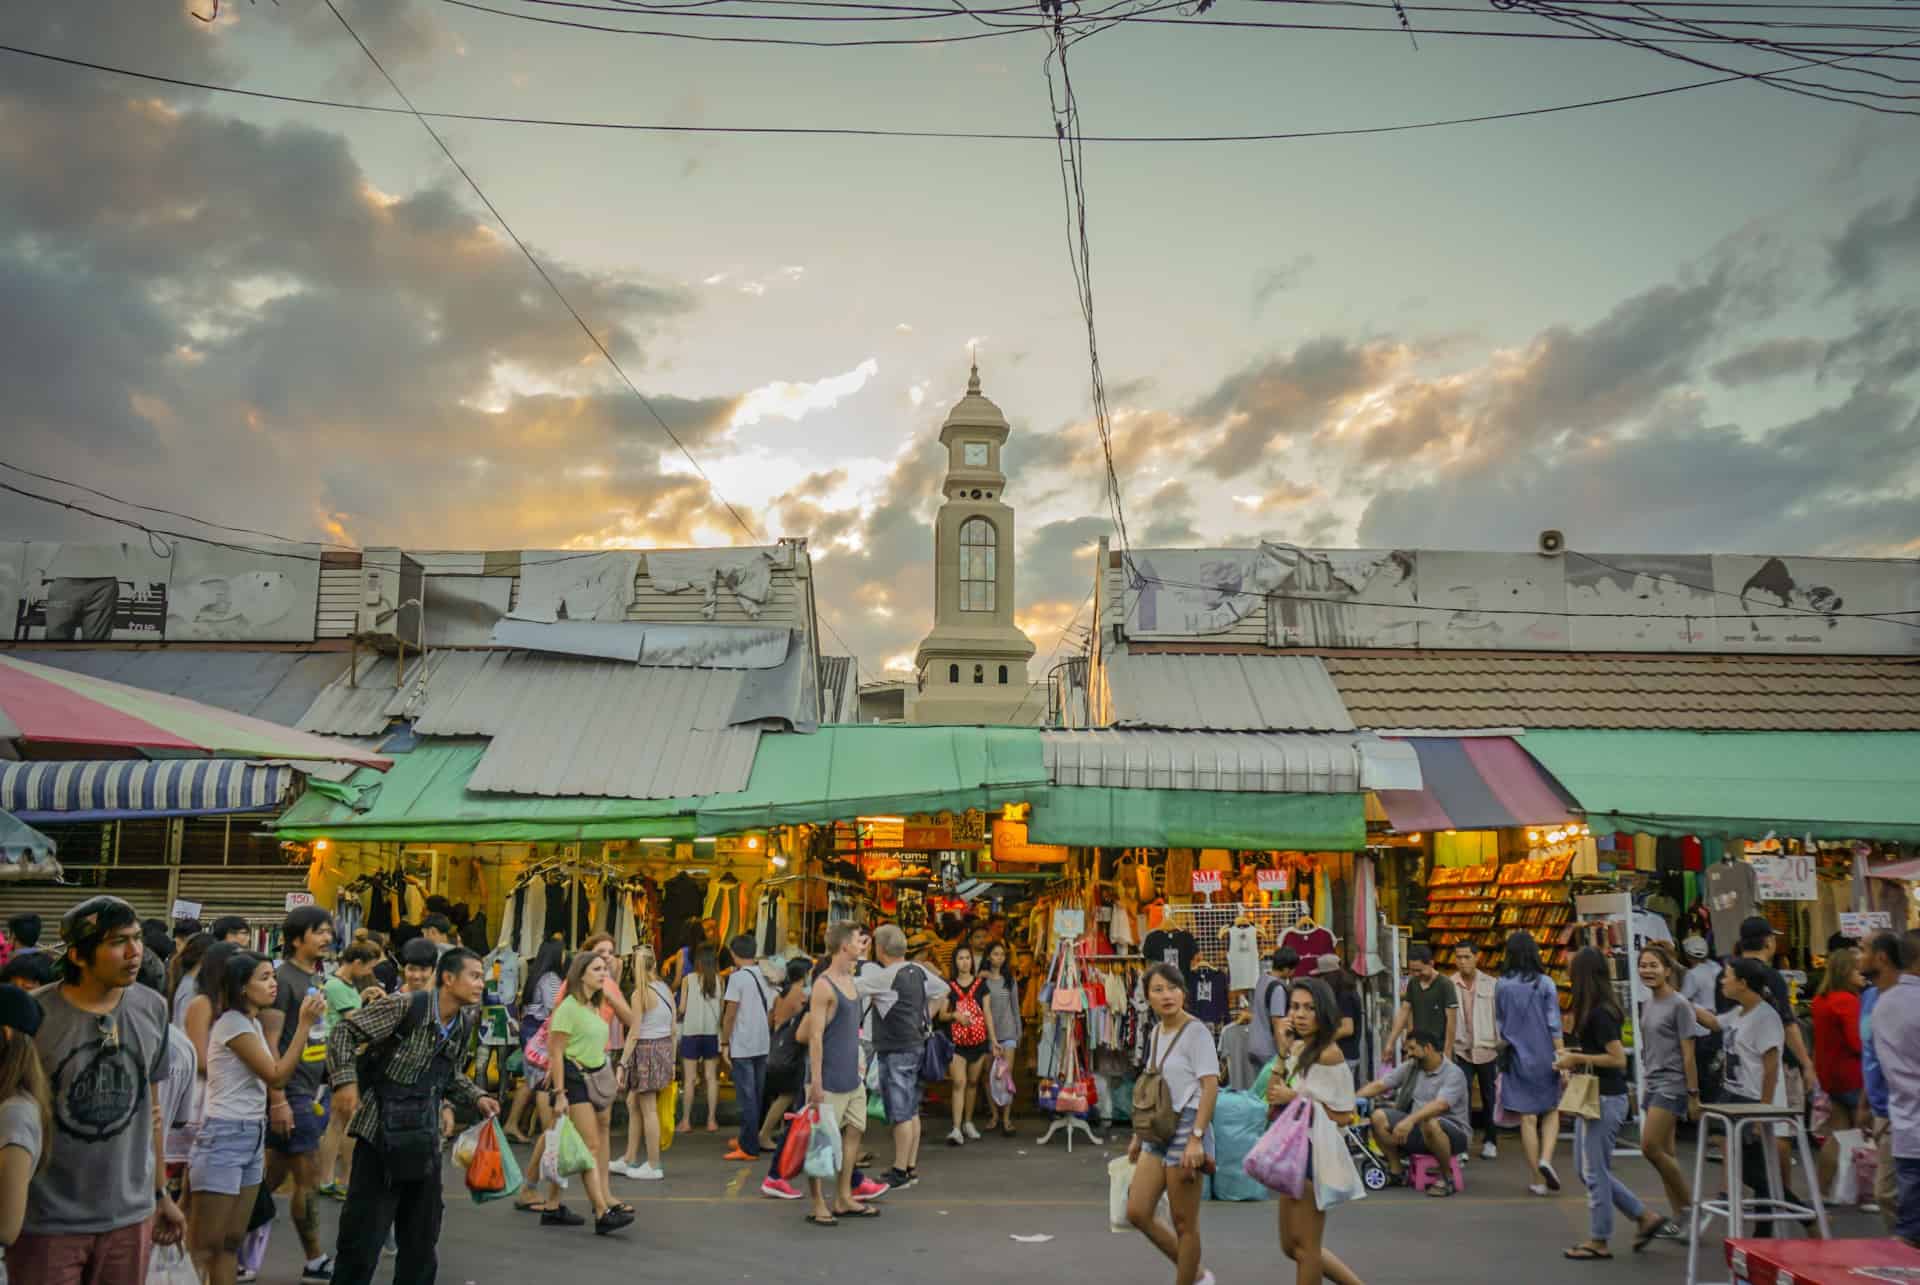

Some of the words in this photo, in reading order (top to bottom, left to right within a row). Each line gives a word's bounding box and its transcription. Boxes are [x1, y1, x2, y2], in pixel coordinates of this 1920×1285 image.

[892, 851, 928, 859] Aroma
[1193, 870, 1221, 882] SALE
[1256, 869, 1287, 881] SALE
